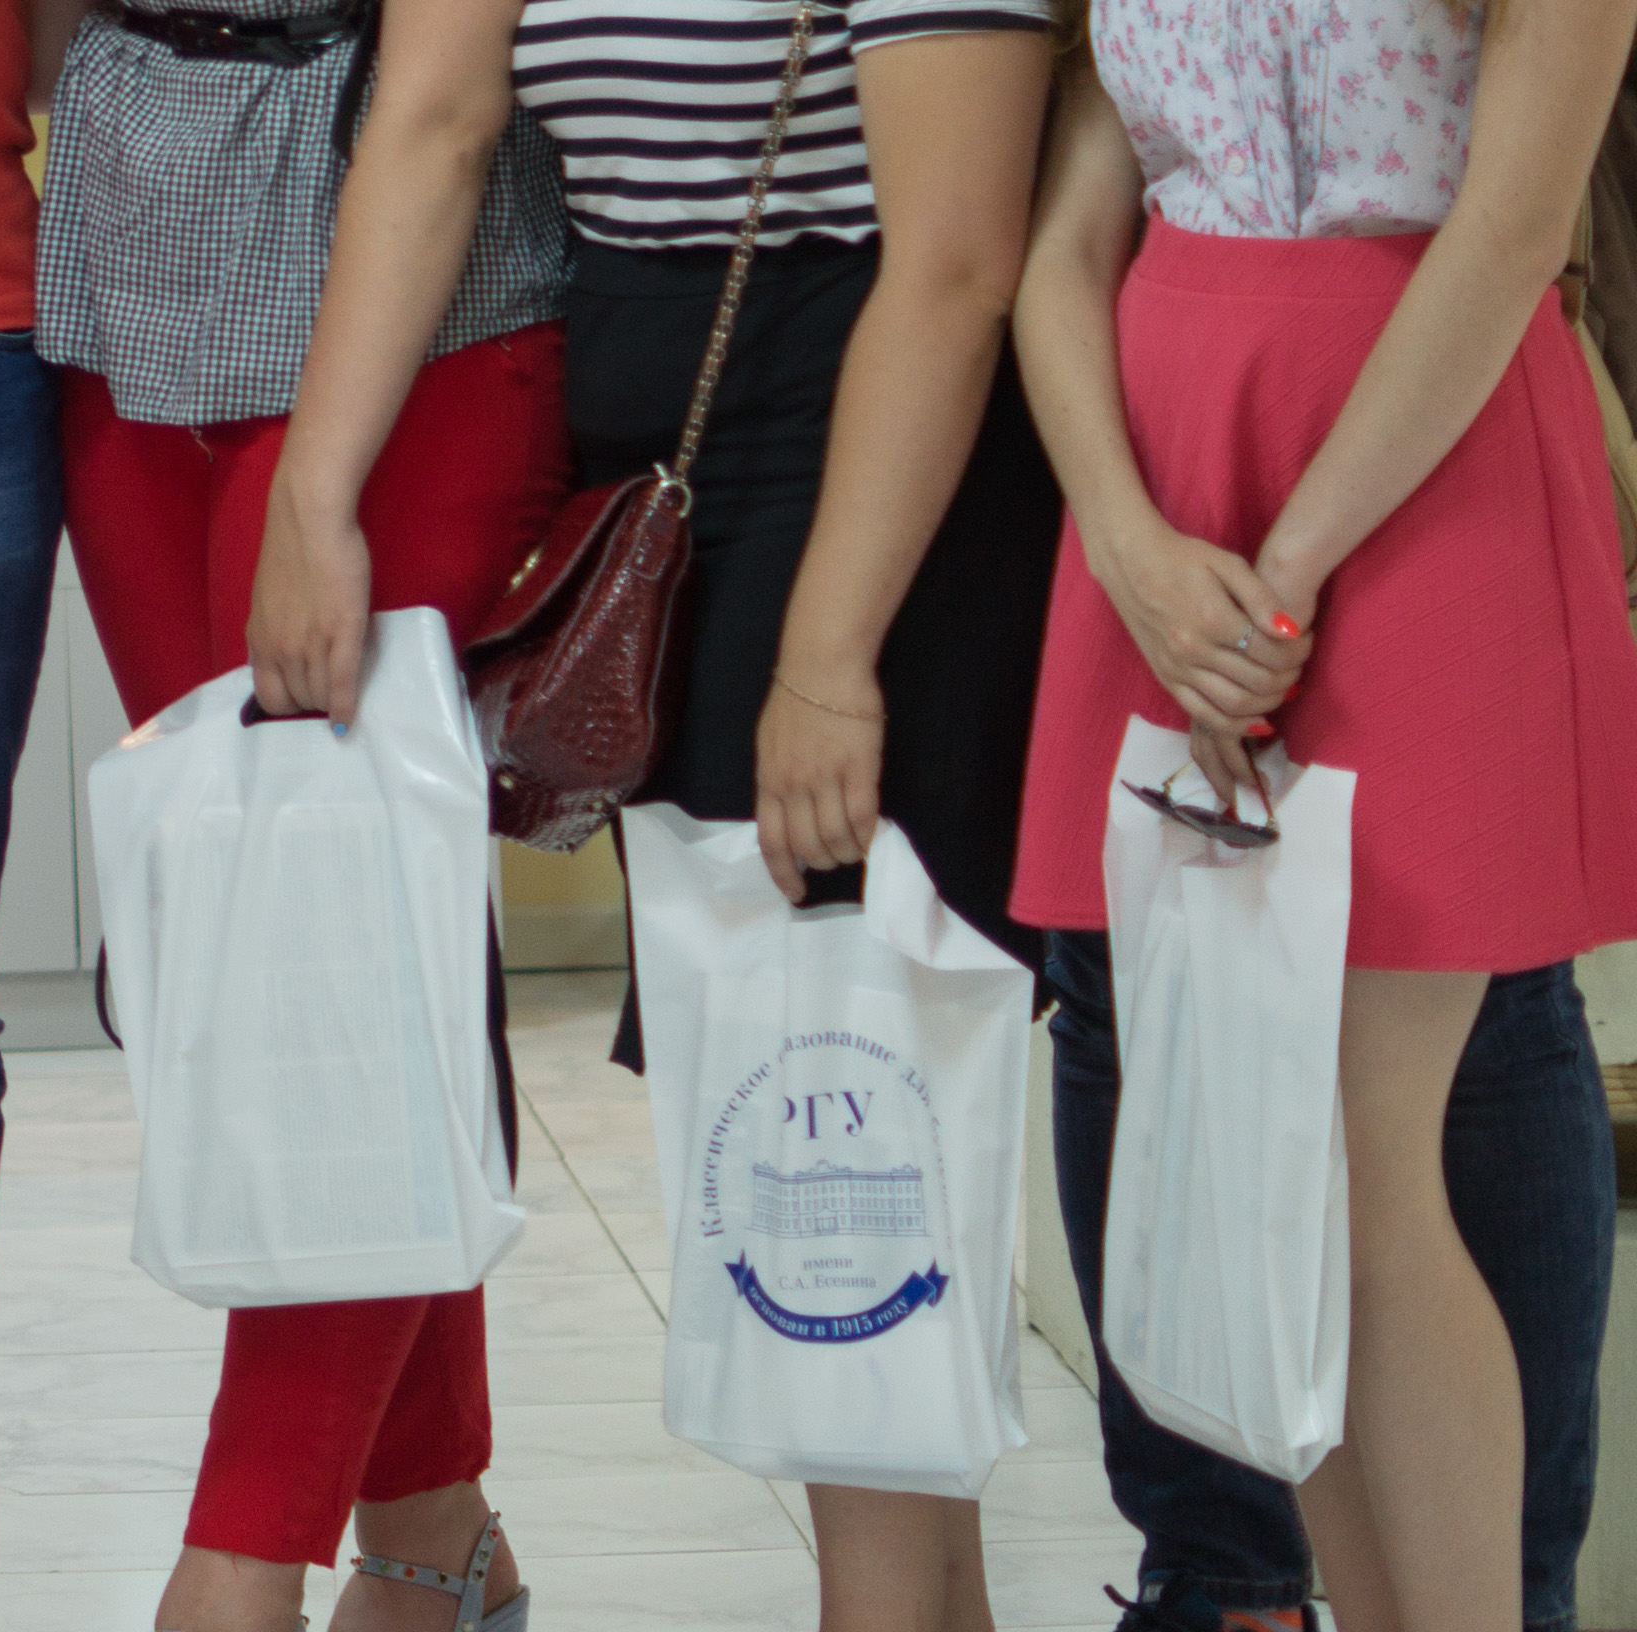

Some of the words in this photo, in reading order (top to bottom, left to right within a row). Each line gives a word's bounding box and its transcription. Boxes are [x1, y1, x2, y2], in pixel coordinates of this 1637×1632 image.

[699, 1061, 772, 1237] Классическое
[803, 1257, 854, 1272] имени
[815, 1274, 878, 1290] Есенина
[748, 1285, 809, 1337] основан
[831, 1313, 874, 1338] 1915
[876, 1295, 910, 1328] году
